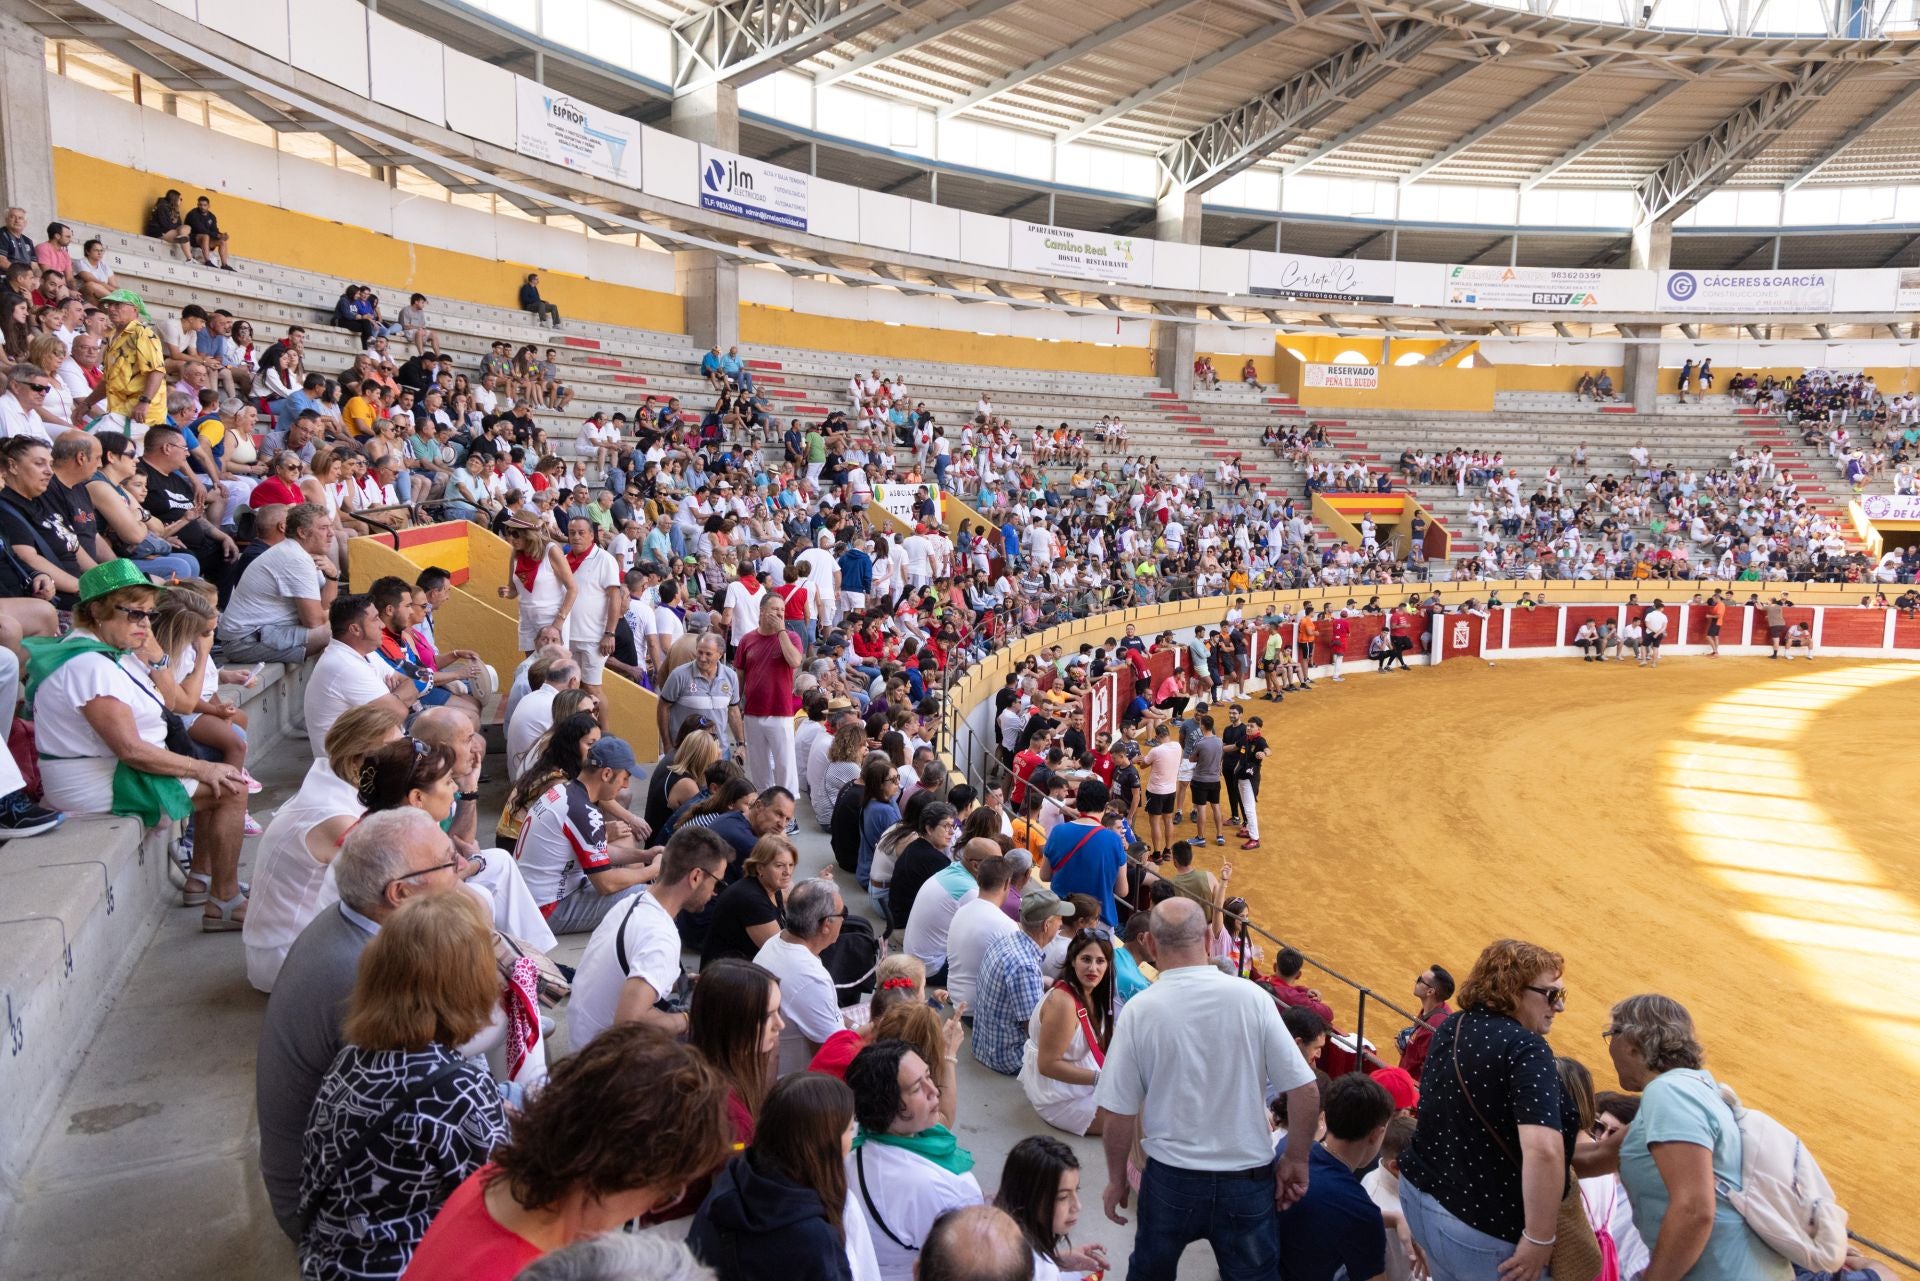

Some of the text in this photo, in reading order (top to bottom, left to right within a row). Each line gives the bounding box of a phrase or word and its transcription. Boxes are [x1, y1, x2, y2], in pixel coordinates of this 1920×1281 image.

[727, 160, 753, 192] jlm
[734, 188, 767, 202] ELECTRICIDAD
[1028, 225, 1074, 238] APARTAMENTOS
[1044, 238, 1107, 256] Camino Real
[1281, 260, 1330, 290] Carlota
[1328, 366, 1375, 376] RESERVADO
[1325, 375, 1343, 387] PEÑA
[1345, 378, 1353, 387] EL
[1354, 378, 1377, 388] RUEDO
[1893, 509, 1908, 518] DE
[63, 943, 73, 978] 34
[10, 1017, 23, 1056] 33
